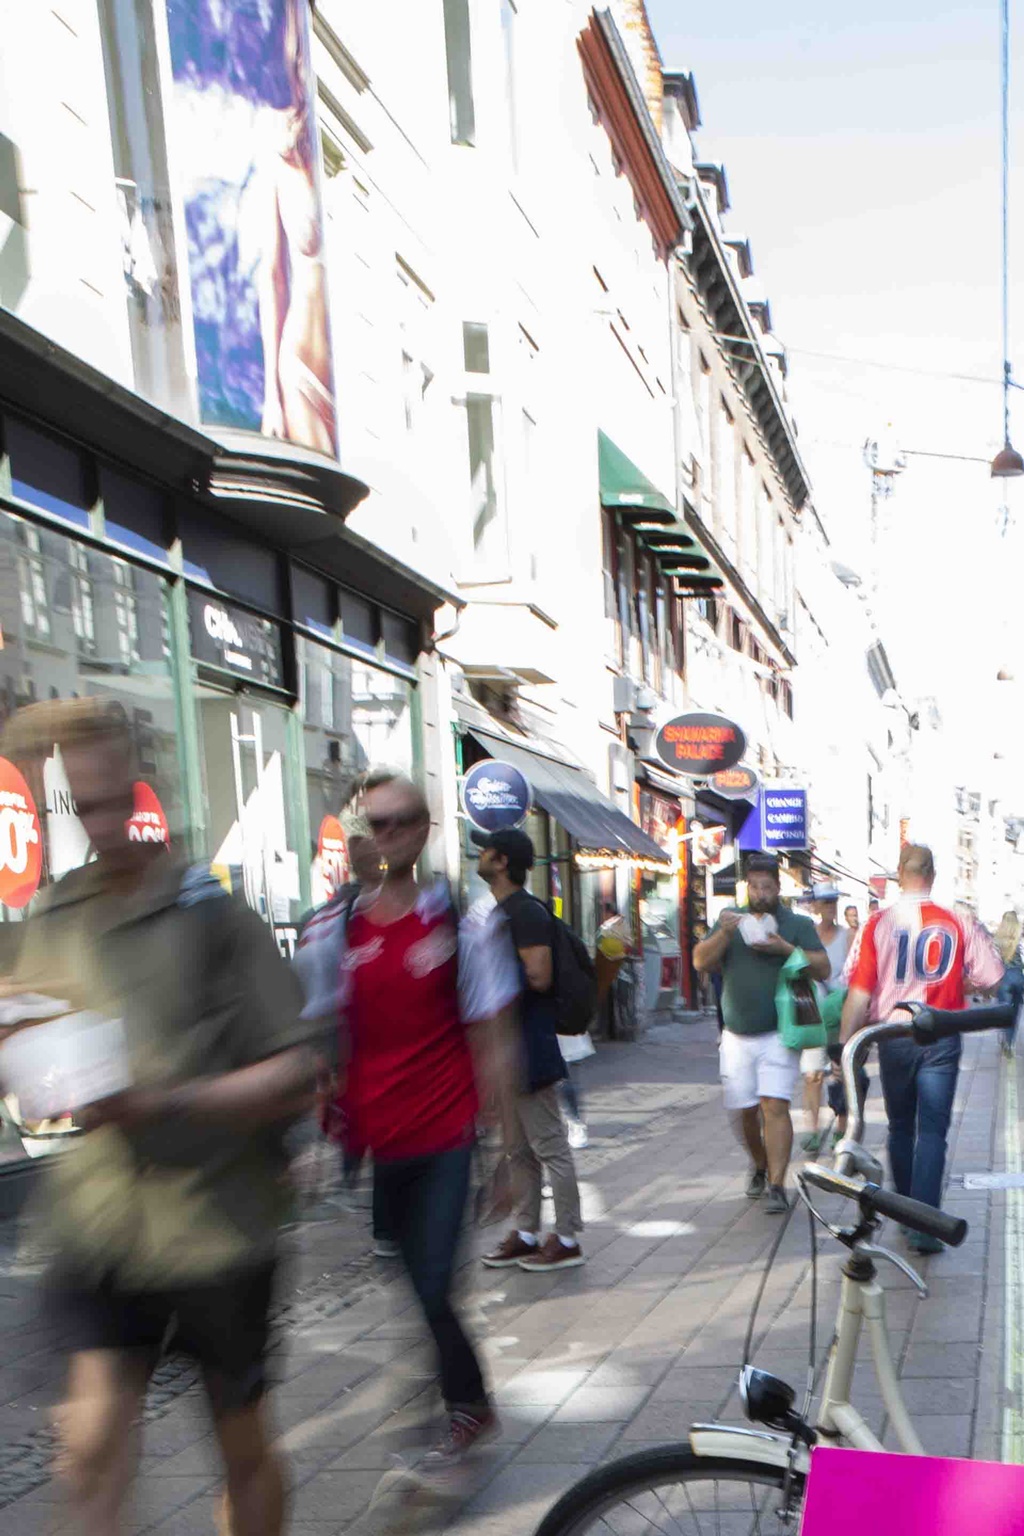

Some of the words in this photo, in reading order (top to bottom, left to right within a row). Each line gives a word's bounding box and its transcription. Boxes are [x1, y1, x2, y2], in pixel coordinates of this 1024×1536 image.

[676, 743, 724, 760] PALACE
[767, 797, 803, 808] CHANGE
[893, 927, 958, 984] 10
